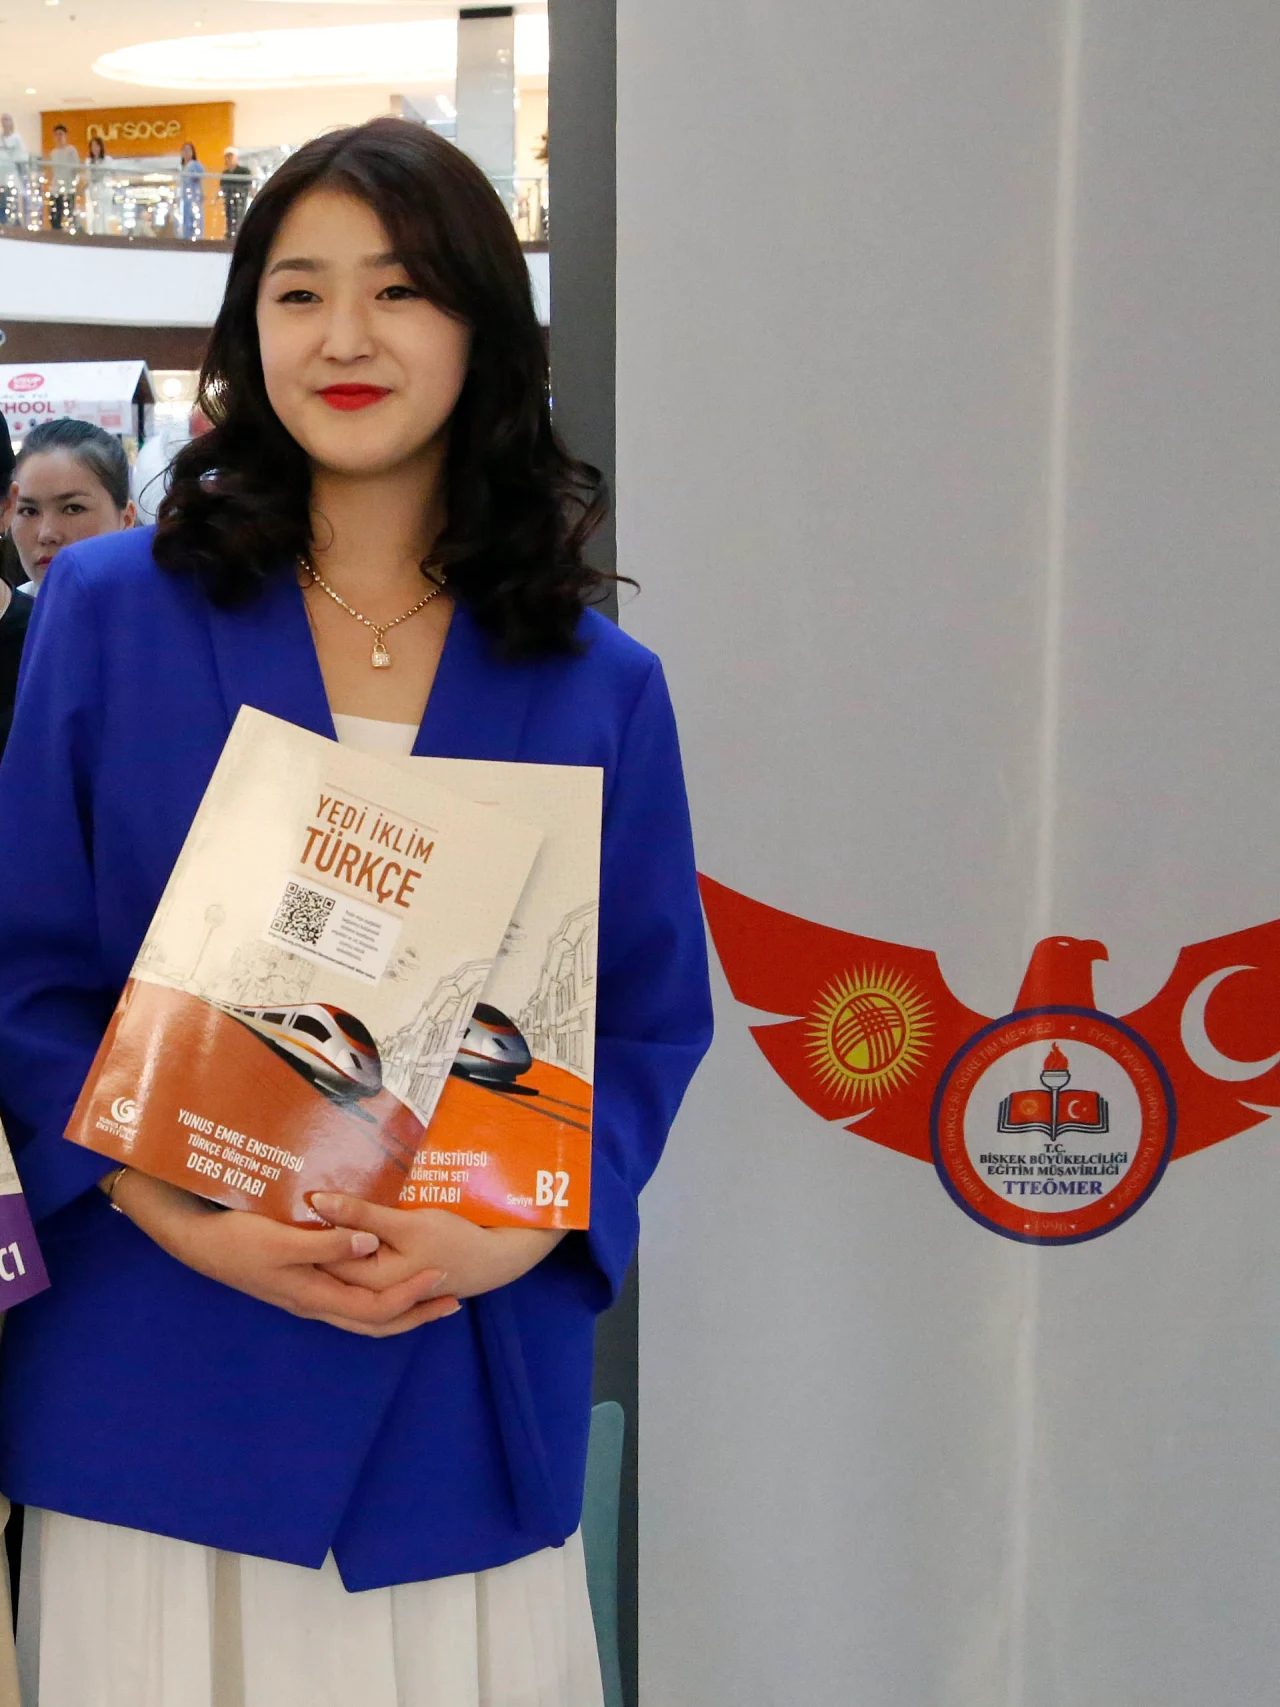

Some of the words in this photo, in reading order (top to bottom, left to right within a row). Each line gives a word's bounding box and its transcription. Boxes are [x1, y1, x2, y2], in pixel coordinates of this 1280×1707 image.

[316, 793, 369, 834] YEDİ
[369, 812, 435, 864] İKLİM
[300, 825, 422, 909] TÜRKÇE
[177, 1108, 215, 1135] YUNUS
[214, 1124, 246, 1148] EMRE
[246, 1138, 304, 1172] ENSTİTÜSÜ
[187, 1133, 222, 1156] TÜRKÇE
[221, 1146, 261, 1172] ÖĞRETİM
[260, 1164, 281, 1181] SETİ
[430, 1149, 488, 1168] ENSTİTÜSÜ
[1044, 1143, 1066, 1153] T.C.
[186, 1152, 223, 1179] DERS
[222, 1167, 266, 1198] KİTABI
[410, 1167, 449, 1182] ÖĞRETİM
[420, 1182, 461, 1203] KİTABI
[506, 1193, 533, 1208] Seviye
[535, 1169, 570, 1207] B2
[1003, 1178, 1103, 1195] TTEÖMER
